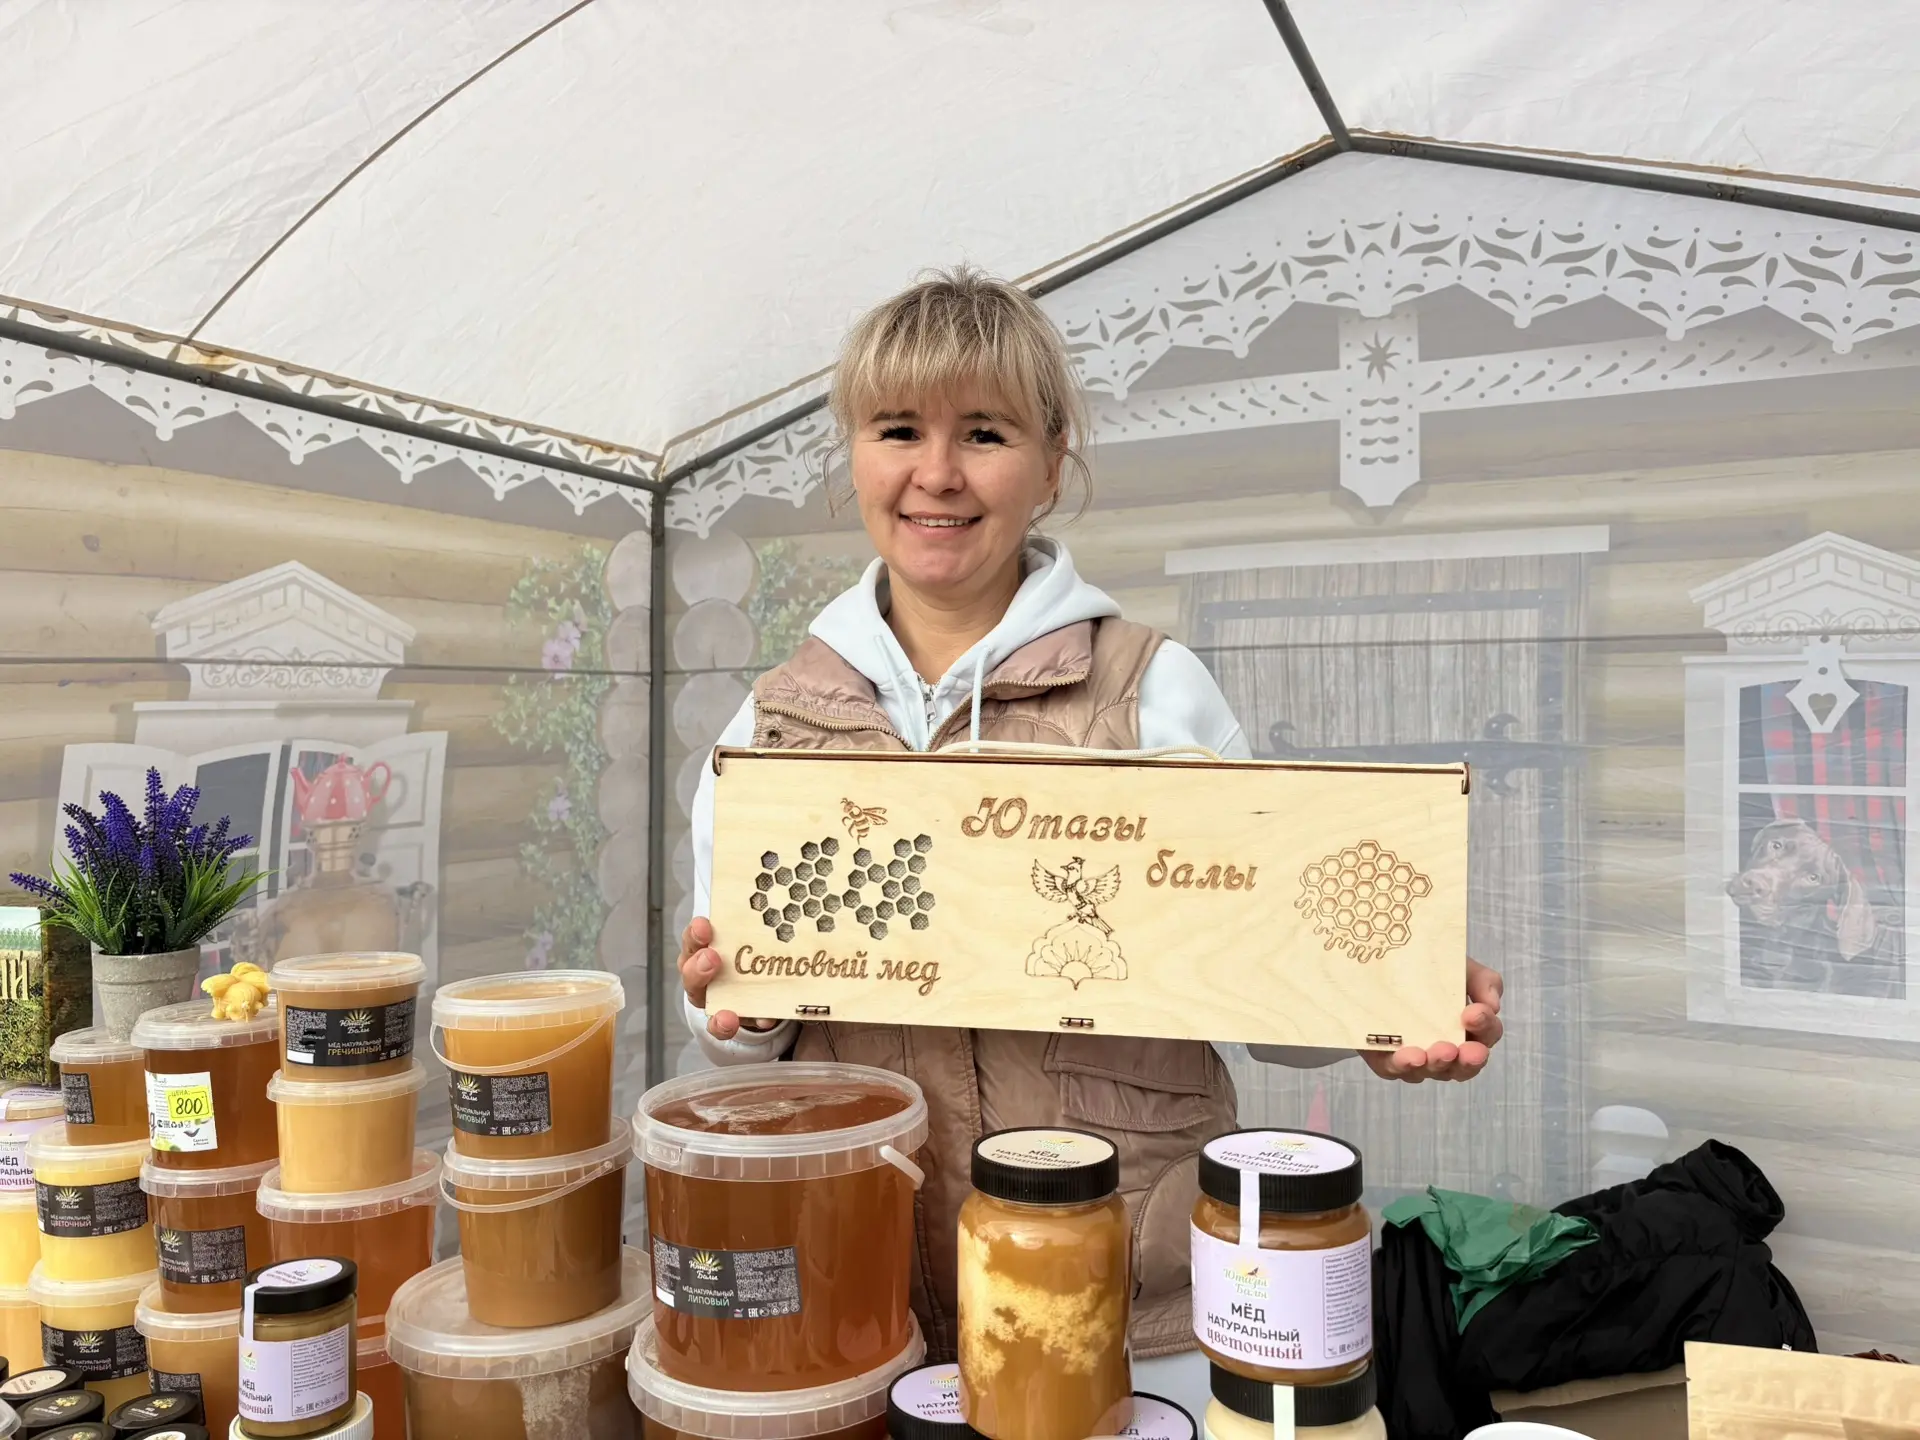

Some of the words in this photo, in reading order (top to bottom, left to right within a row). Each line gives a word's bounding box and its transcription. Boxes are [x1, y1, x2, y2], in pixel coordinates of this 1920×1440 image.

[961, 797, 1148, 842] Ютазы
[1146, 848, 1258, 891] балы
[734, 944, 869, 979] Сотовый
[876, 959, 942, 996] мед
[341, 1037, 383, 1048] НАТУРАЛЬНЫЙ
[327, 1046, 382, 1056] ГРЕЧИШНЫЙ
[176, 1097, 203, 1115] 800
[995, 1148, 1081, 1165] НАТУРАЛЬНЫЙ
[1028, 1149, 1060, 1159] МЁД
[1222, 1151, 1319, 1169] НАТУРАЛЬНЫЙ
[1259, 1151, 1294, 1161] МЁД
[0, 1167, 34, 1176] РАЛЬНЫ
[1223, 1267, 1268, 1289] Ютазы
[694, 1287, 735, 1298] НАТУРАЛЬНЫЙ
[1234, 1283, 1268, 1299] Балы
[687, 1294, 731, 1307] ЛИПОВЫЙ
[1231, 1302, 1266, 1324] МЁД
[1207, 1311, 1301, 1342] НАТУРАЛЬНЫЙ
[1206, 1327, 1303, 1360] цветочный
[79, 1363, 112, 1372] ТОЧНЫЙ
[916, 1400, 960, 1409] НАТУРА
